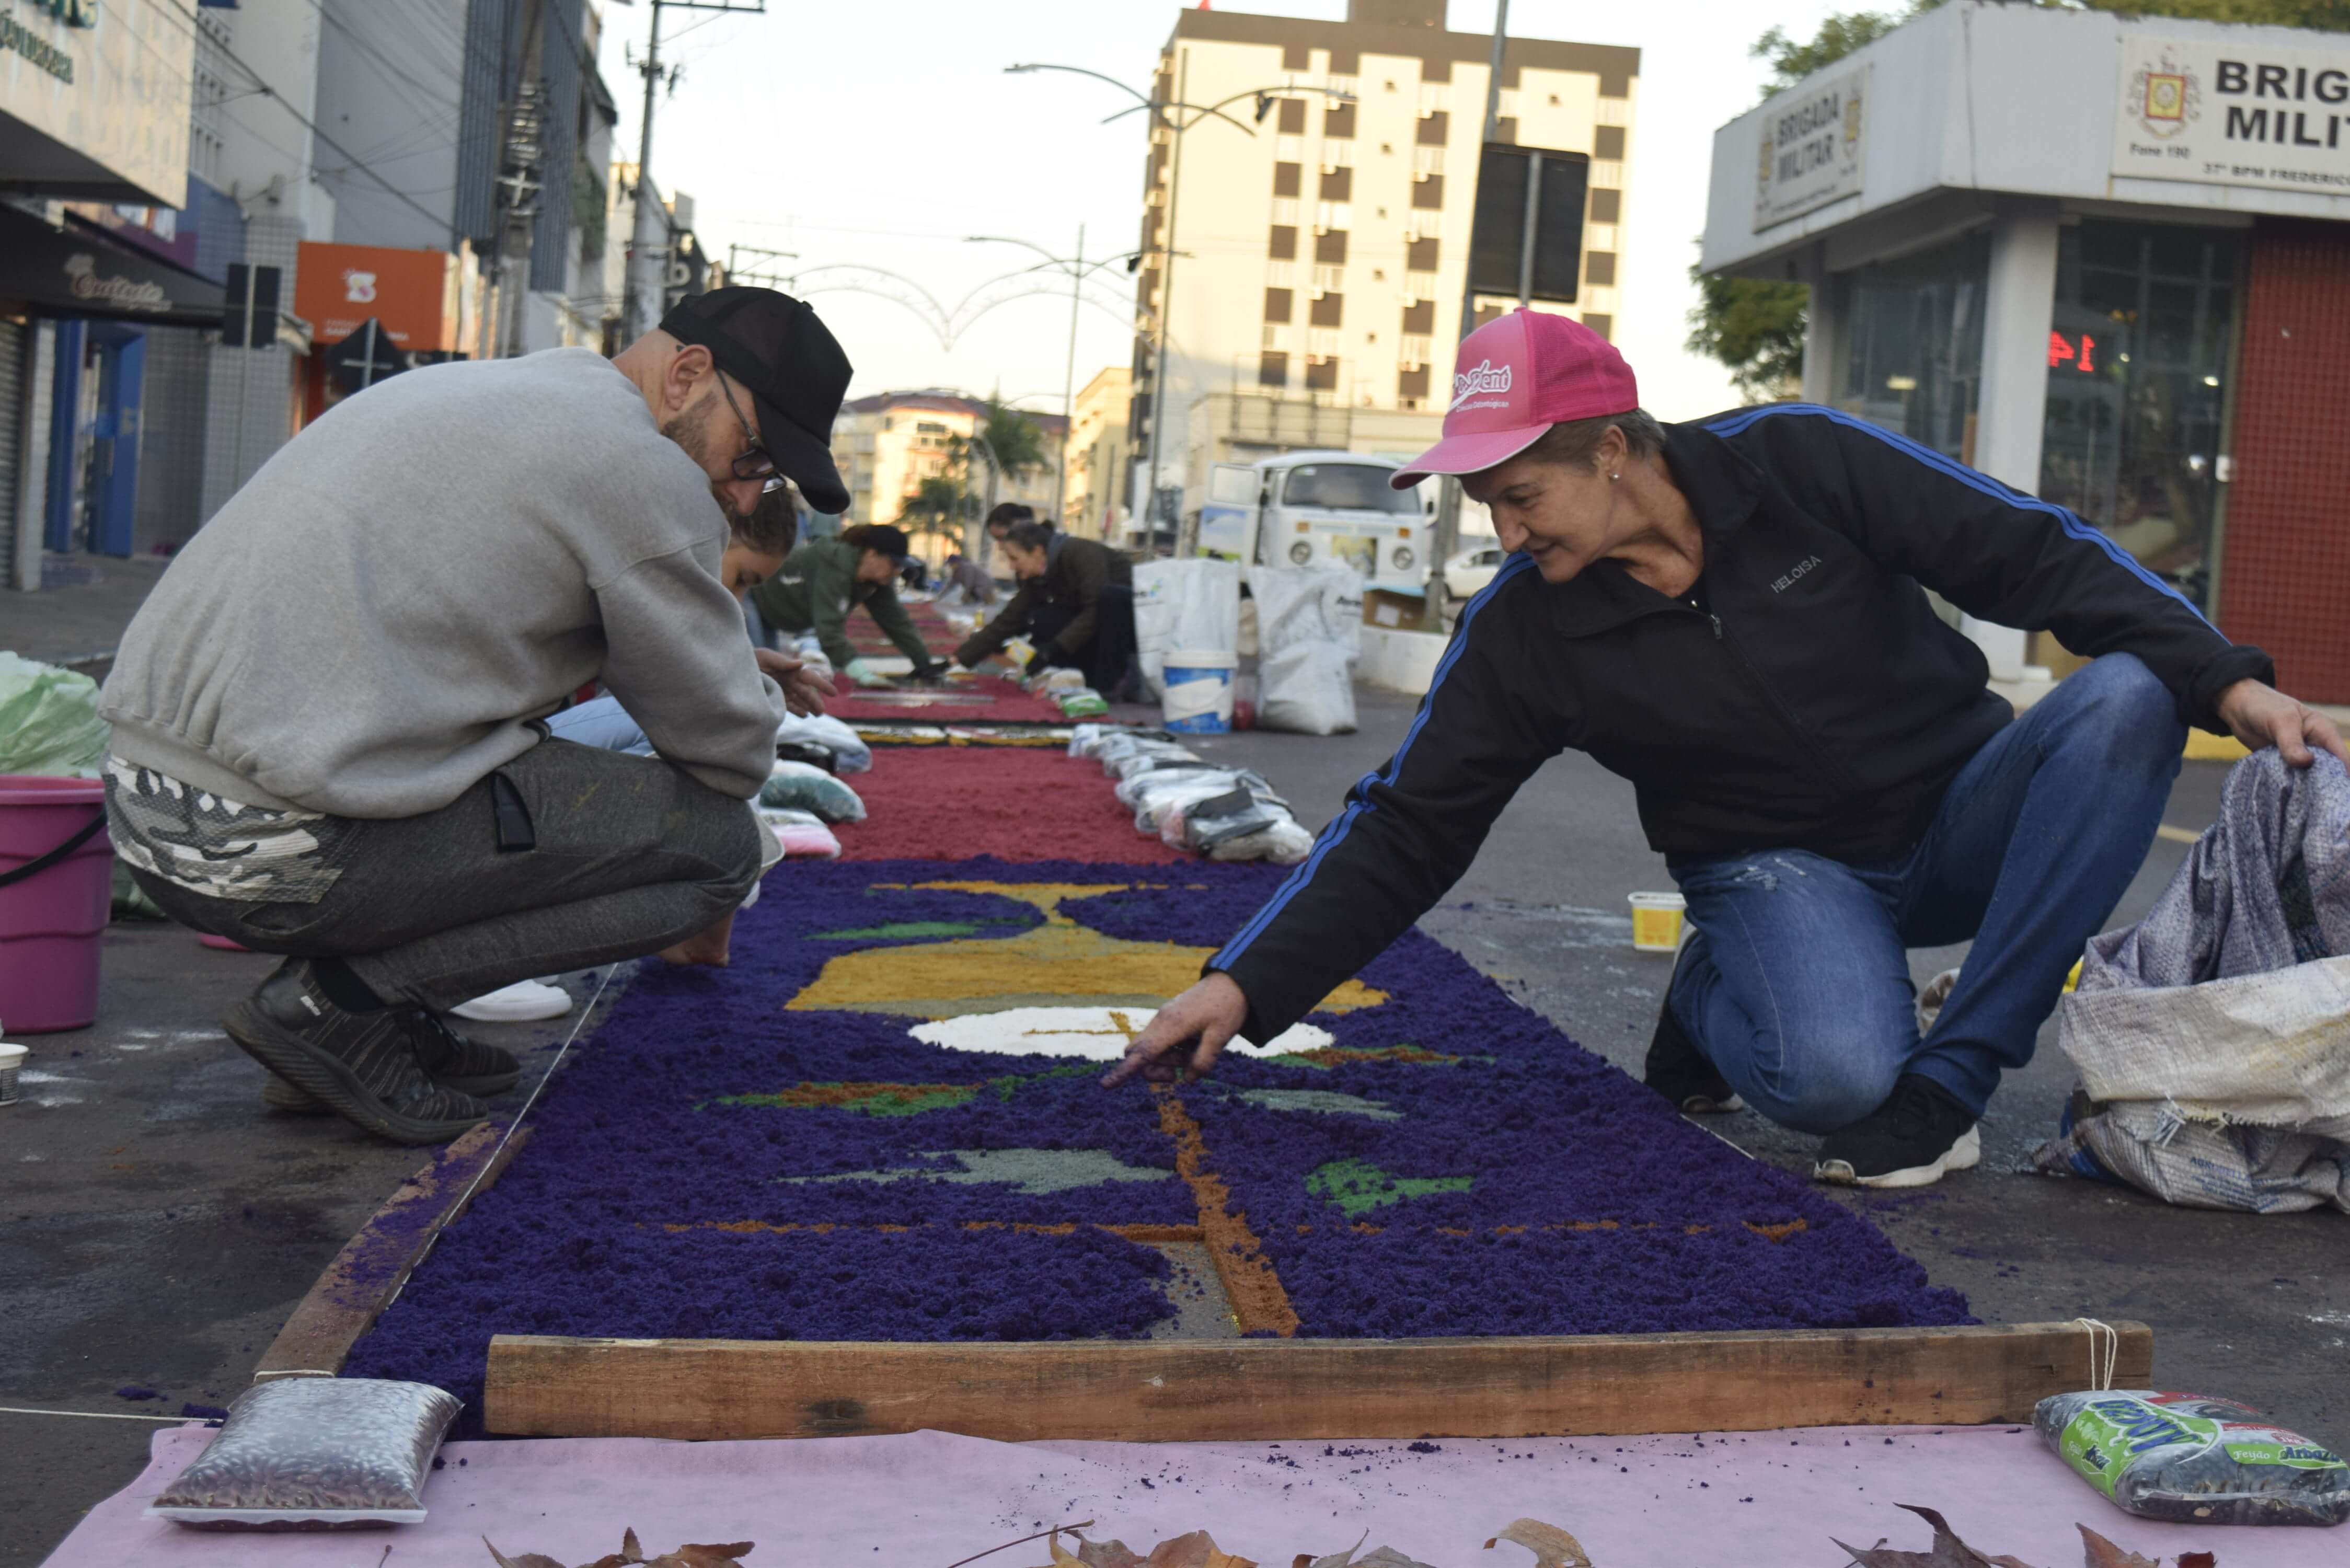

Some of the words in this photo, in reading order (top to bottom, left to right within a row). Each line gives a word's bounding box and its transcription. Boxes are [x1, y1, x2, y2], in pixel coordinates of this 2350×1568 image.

[1779, 93, 1838, 147] BRIGADA
[1779, 134, 1834, 183] MILITAR
[2231, 164, 2265, 179] BPM
[1770, 555, 1822, 594] HELOISA
[2233, 1450, 2271, 1461] Feijão
